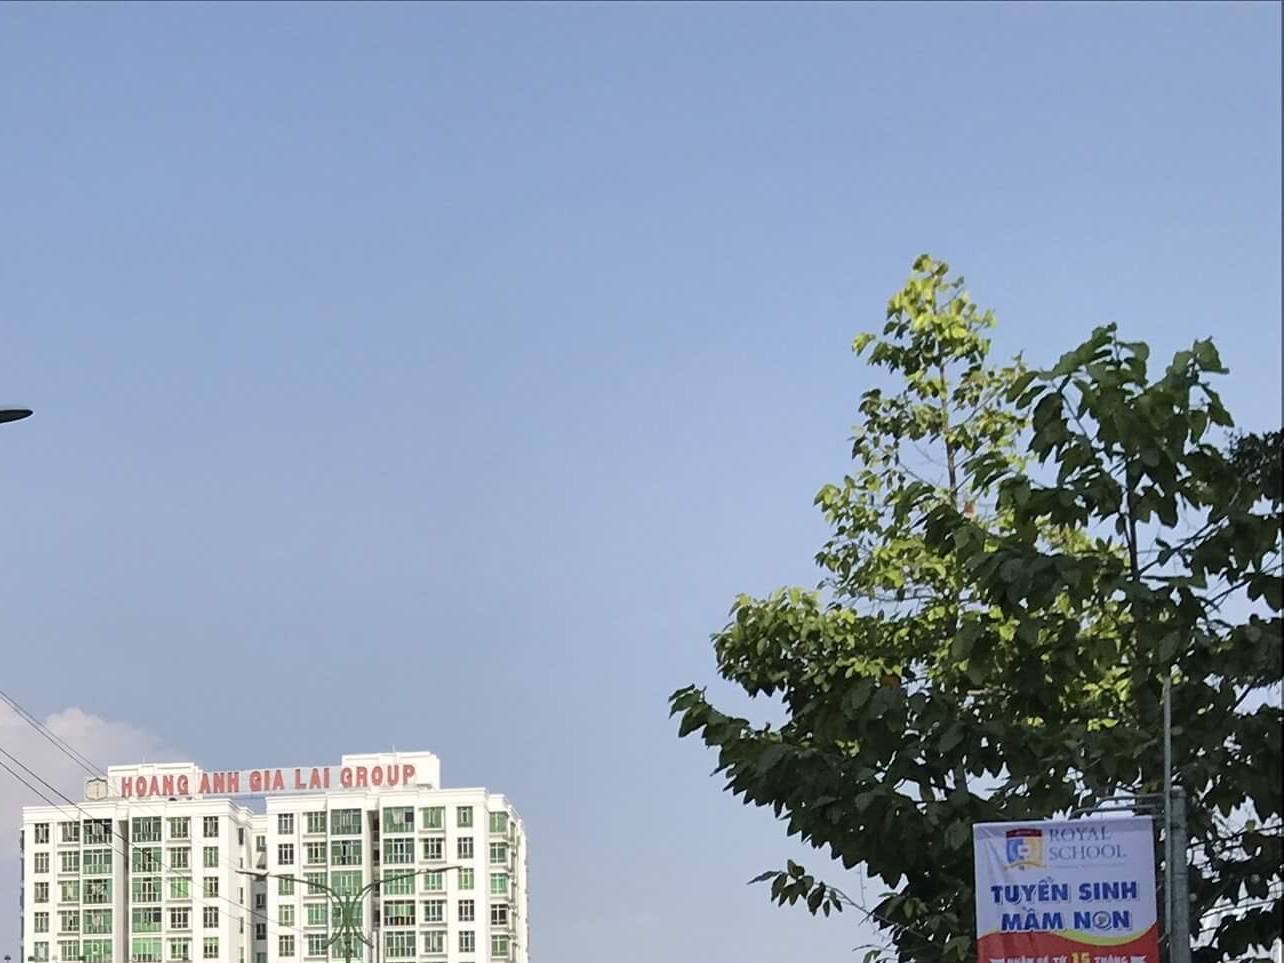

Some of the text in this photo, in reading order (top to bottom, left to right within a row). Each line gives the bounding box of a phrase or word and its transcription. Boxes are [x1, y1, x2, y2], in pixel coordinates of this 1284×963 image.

[199, 771, 240, 794] ANH
[249, 769, 285, 791] GIA
[295, 767, 330, 789] LAI
[340, 765, 416, 786] GROUP
[1049, 825, 1113, 842] ROYAL
[1048, 844, 1128, 861] SCHOOL
[991, 876, 1138, 904] TUYỂN SINH
[1001, 906, 1131, 931] MẦM NON
